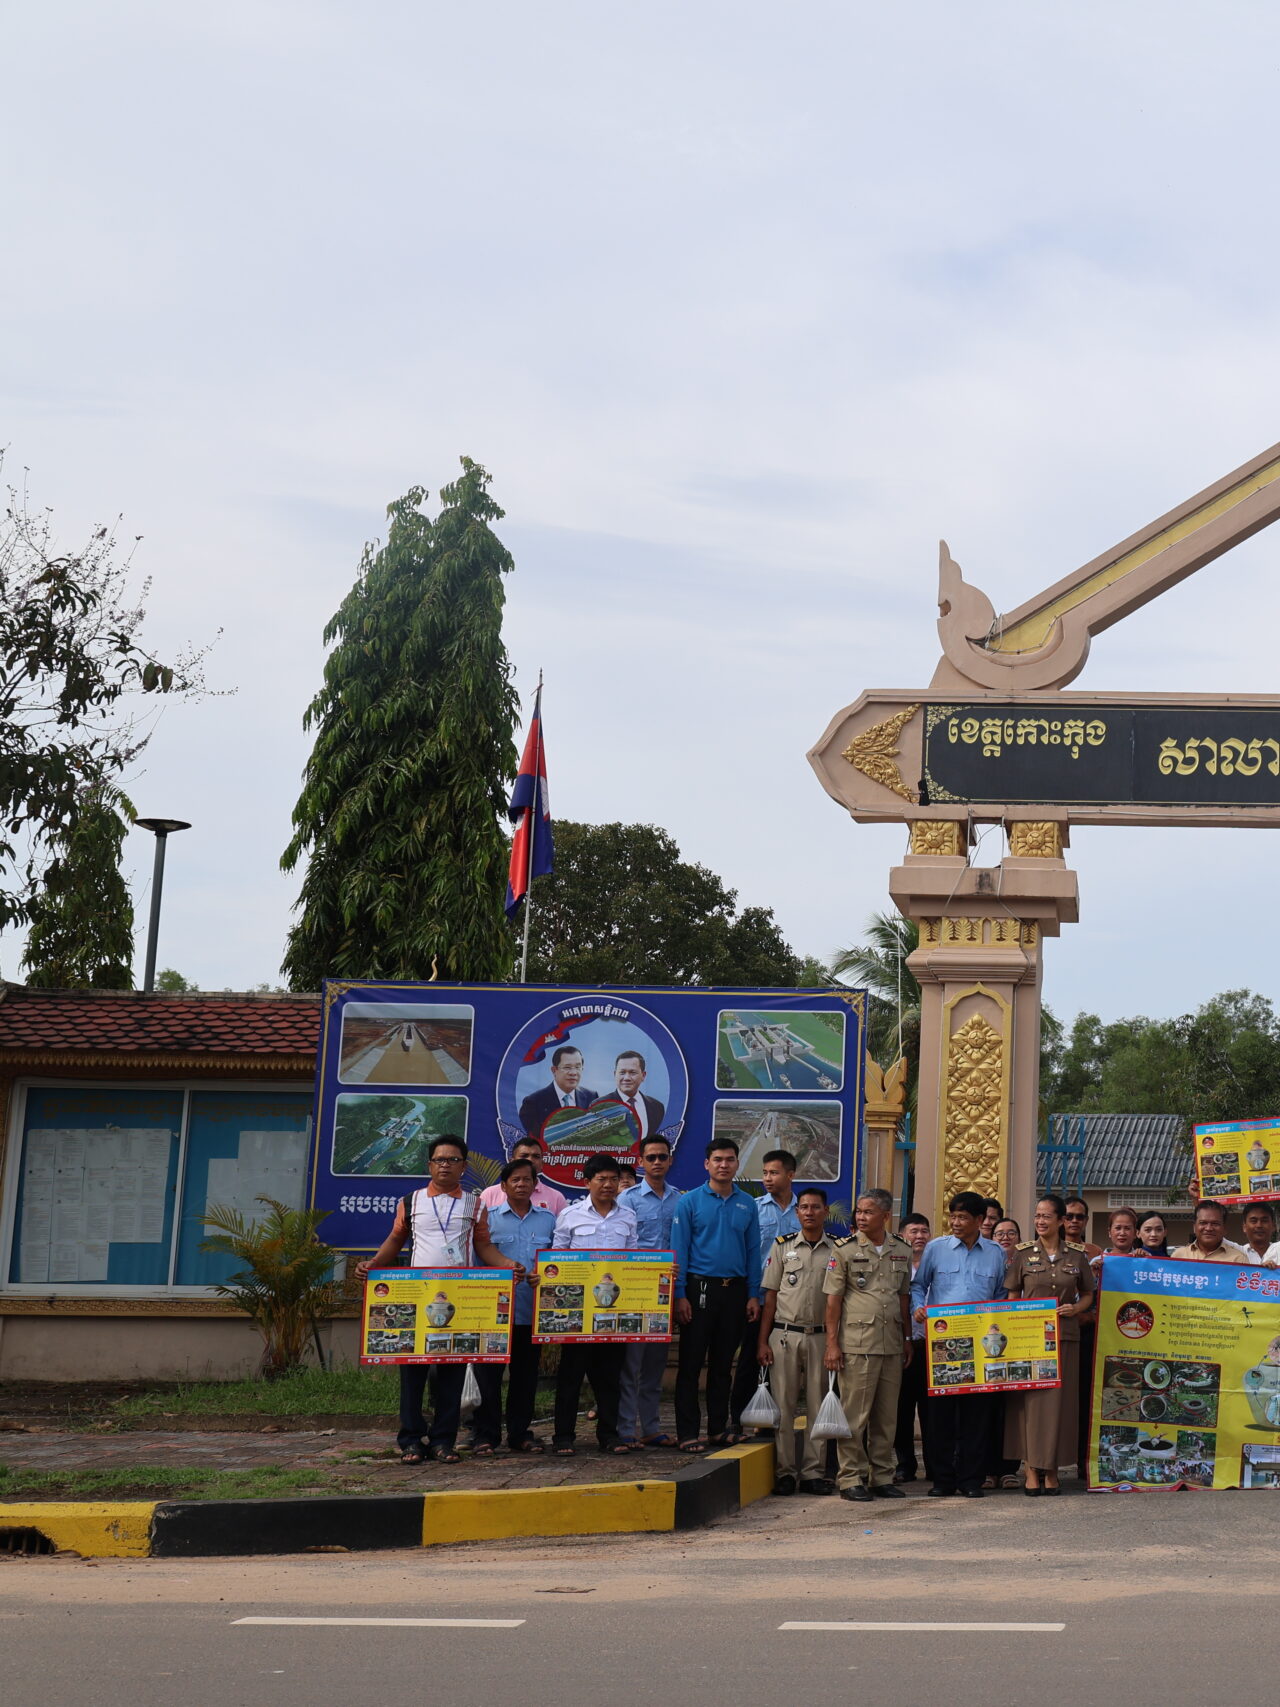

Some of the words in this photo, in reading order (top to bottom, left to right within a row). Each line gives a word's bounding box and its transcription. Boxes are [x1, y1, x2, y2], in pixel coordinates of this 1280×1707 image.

[947, 717, 1107, 759] ខេត្តកោះកុង
[1134, 1270, 1209, 1290] ប្រយ័ត្នមូសខ្លា
